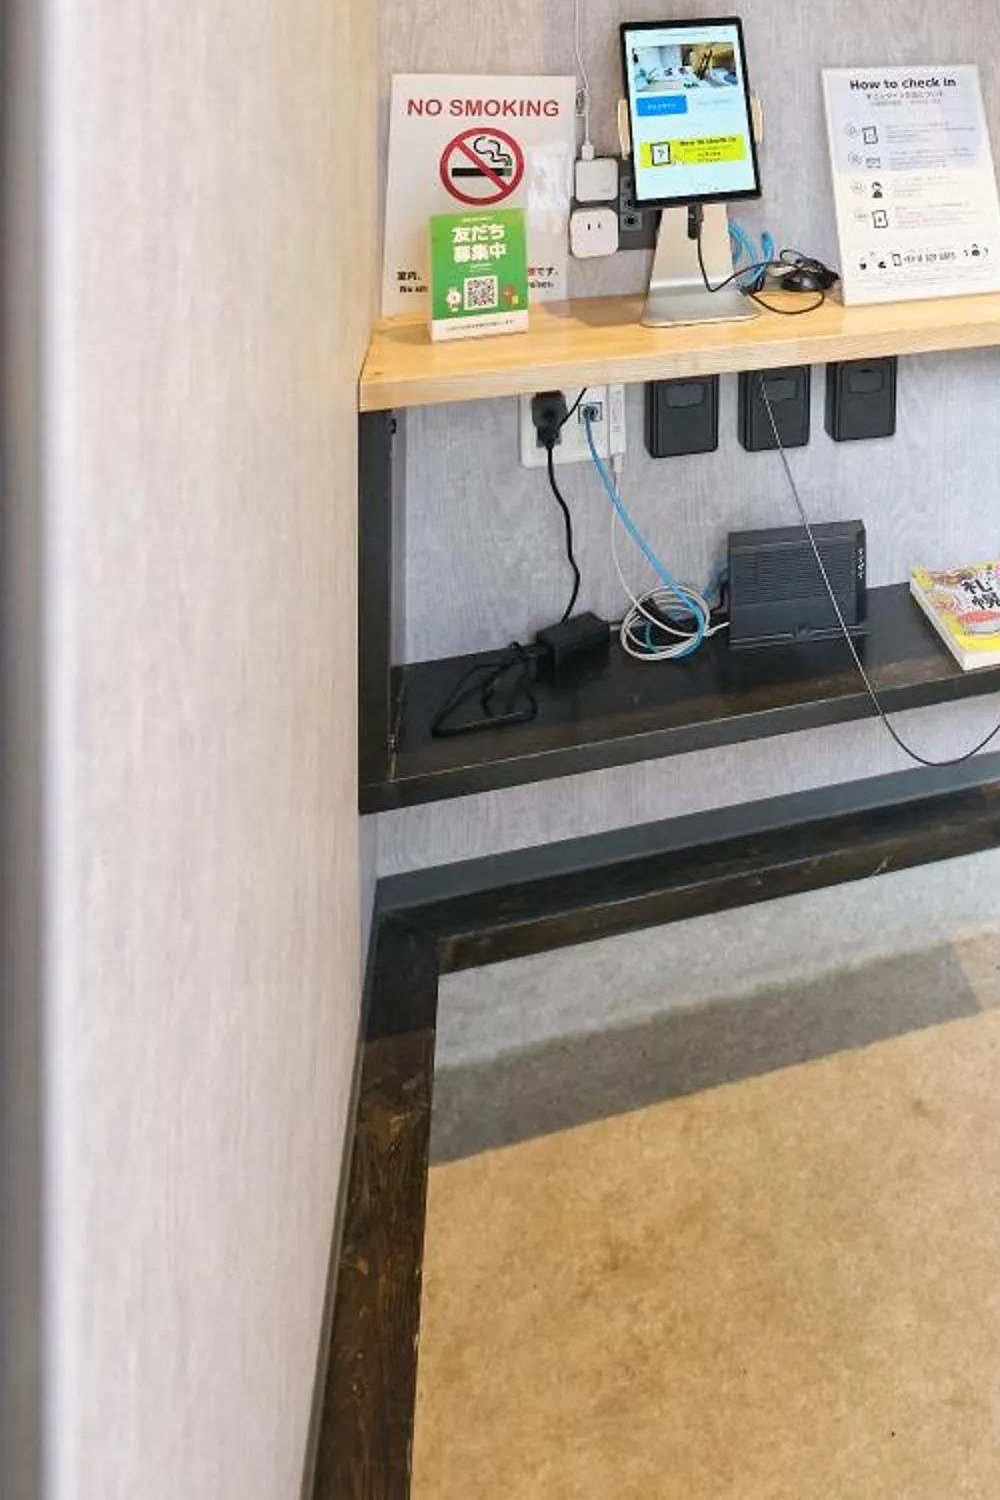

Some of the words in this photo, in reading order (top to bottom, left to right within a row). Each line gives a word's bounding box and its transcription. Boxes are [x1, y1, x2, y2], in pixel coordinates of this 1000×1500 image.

[849, 79, 880, 91] How
[883, 79, 898, 89] to
[901, 77, 940, 89] check
[943, 76, 957, 87] in
[407, 99, 443, 117] NO
[449, 99, 560, 118] SMOKING
[451, 224, 506, 244] 友だち
[453, 242, 507, 264] 募集中
